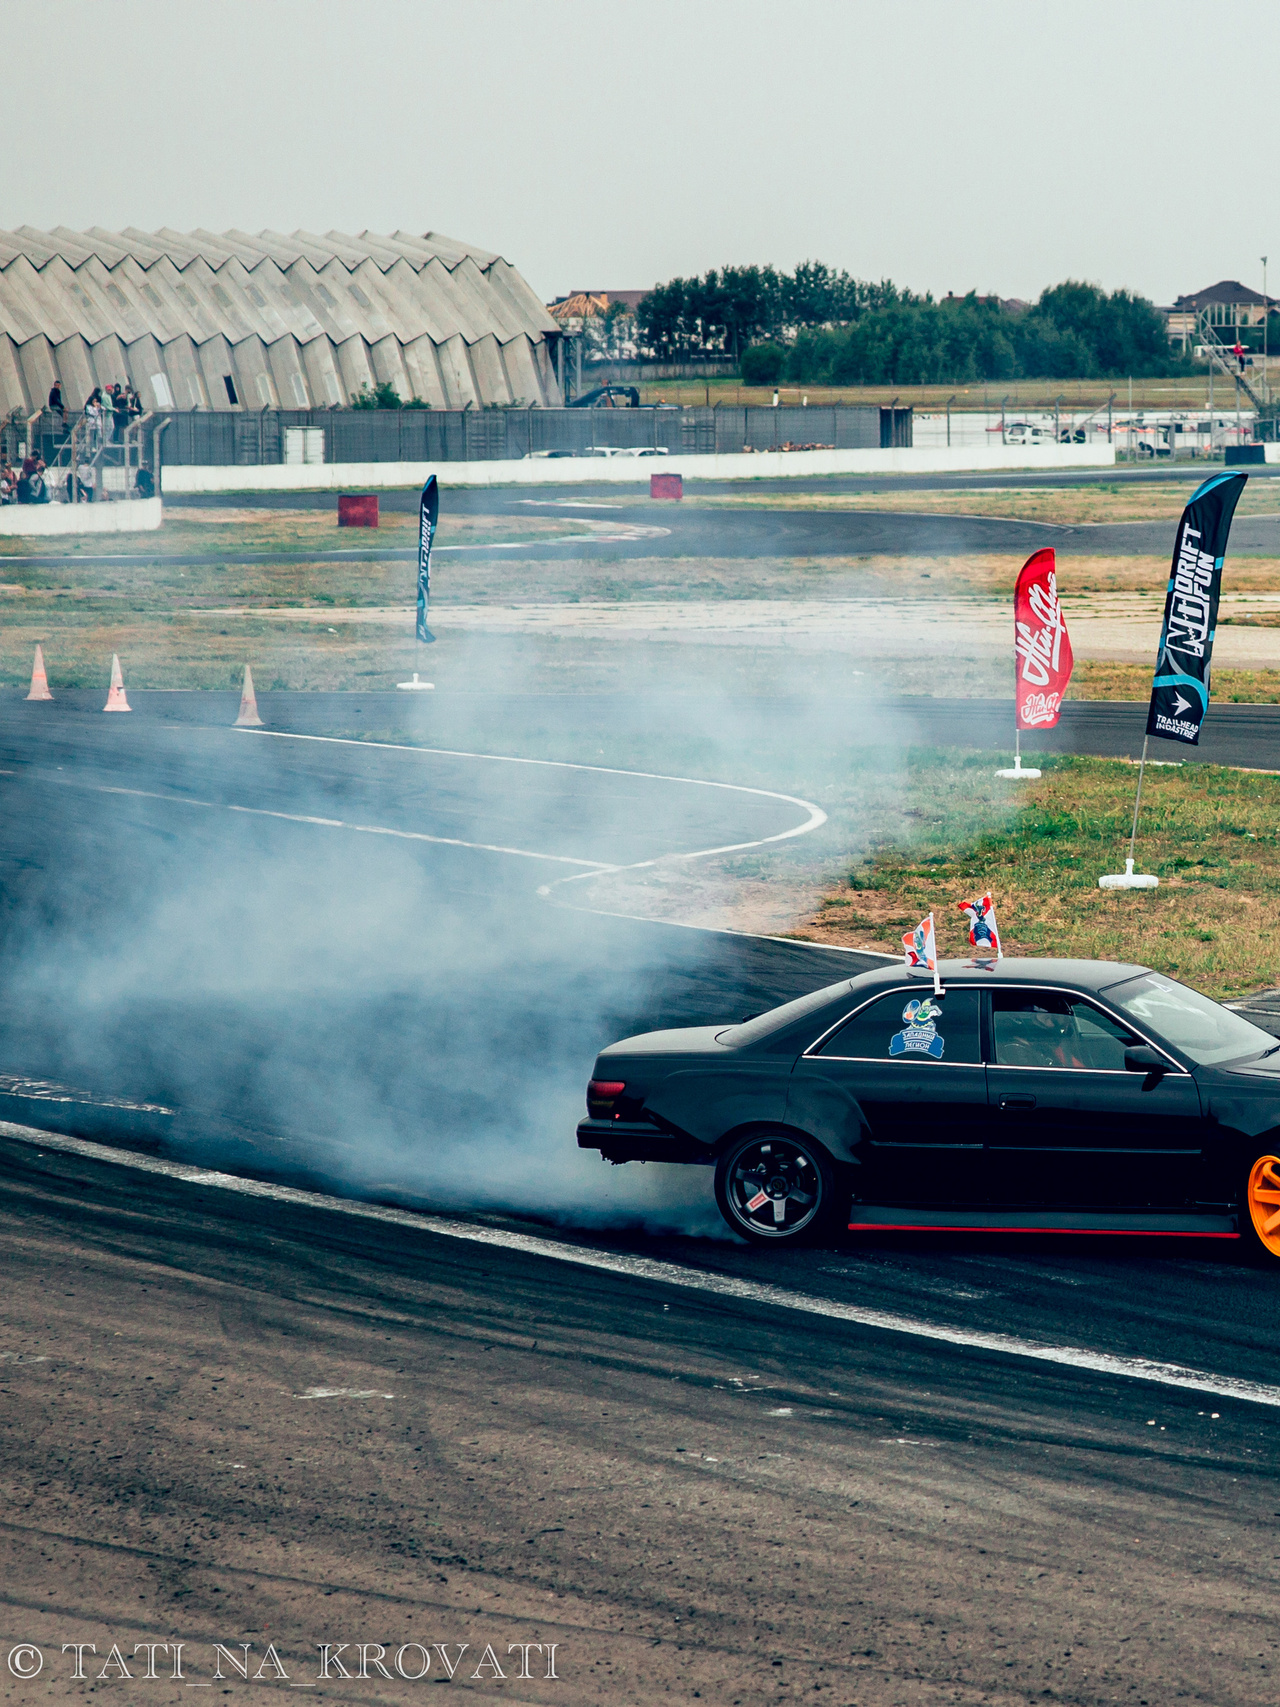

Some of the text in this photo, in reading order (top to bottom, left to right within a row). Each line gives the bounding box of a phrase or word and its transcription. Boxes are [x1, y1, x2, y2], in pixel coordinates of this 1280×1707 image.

[1174, 522, 1202, 594] DRIFT
[1193, 550, 1215, 601] FUN
[1155, 722, 1196, 740] INDASTREE
[1156, 714, 1199, 733] TRAILHEAD
[905, 1041, 930, 1049] ЛЕГИОН
